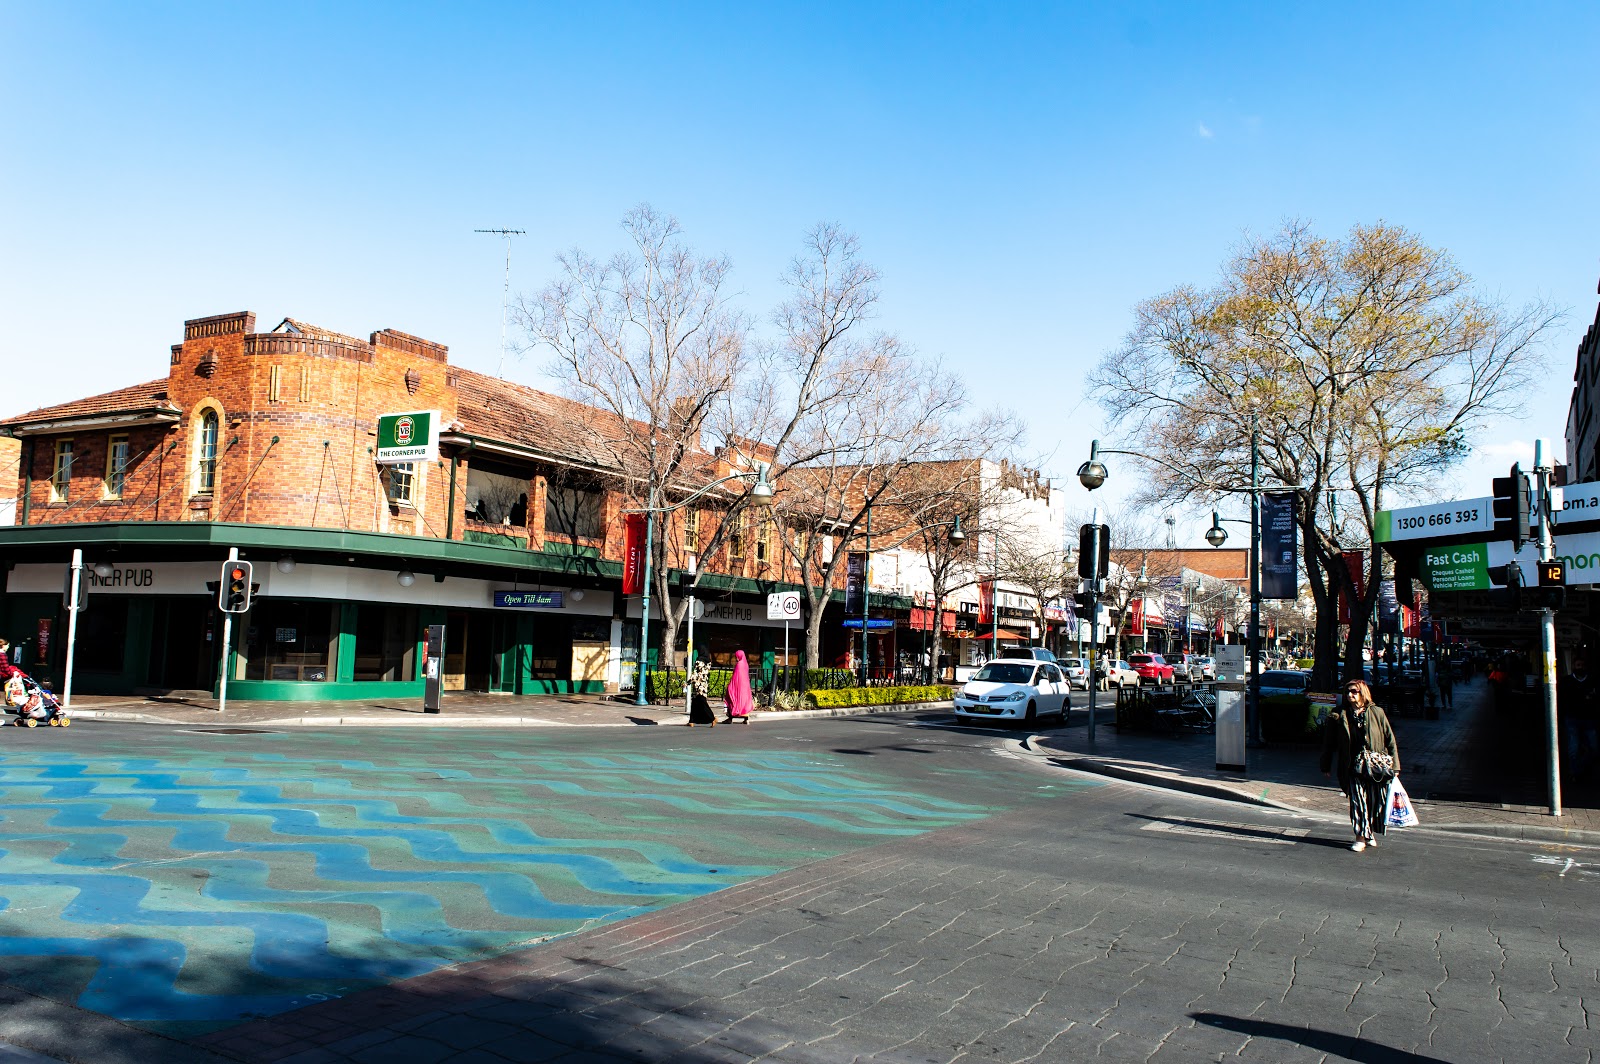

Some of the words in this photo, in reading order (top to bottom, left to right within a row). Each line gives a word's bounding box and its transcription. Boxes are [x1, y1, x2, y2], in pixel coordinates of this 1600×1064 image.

[400, 427, 410, 435] VB
[391, 449, 414, 457] CORNER
[1397, 516, 1425, 530] 1300
[1428, 512, 1451, 526] 666
[1455, 509, 1478, 523] 393
[1426, 553, 1450, 566] Fast
[1452, 550, 1480, 564] Cash
[124, 569, 153, 587] PUB
[1548, 567, 1561, 580] 12
[503, 594, 522, 606] Open
[523, 594, 536, 604] Till
[536, 594, 552, 604] 4am
[785, 601, 798, 610] 40
[735, 607, 752, 621] PUB
